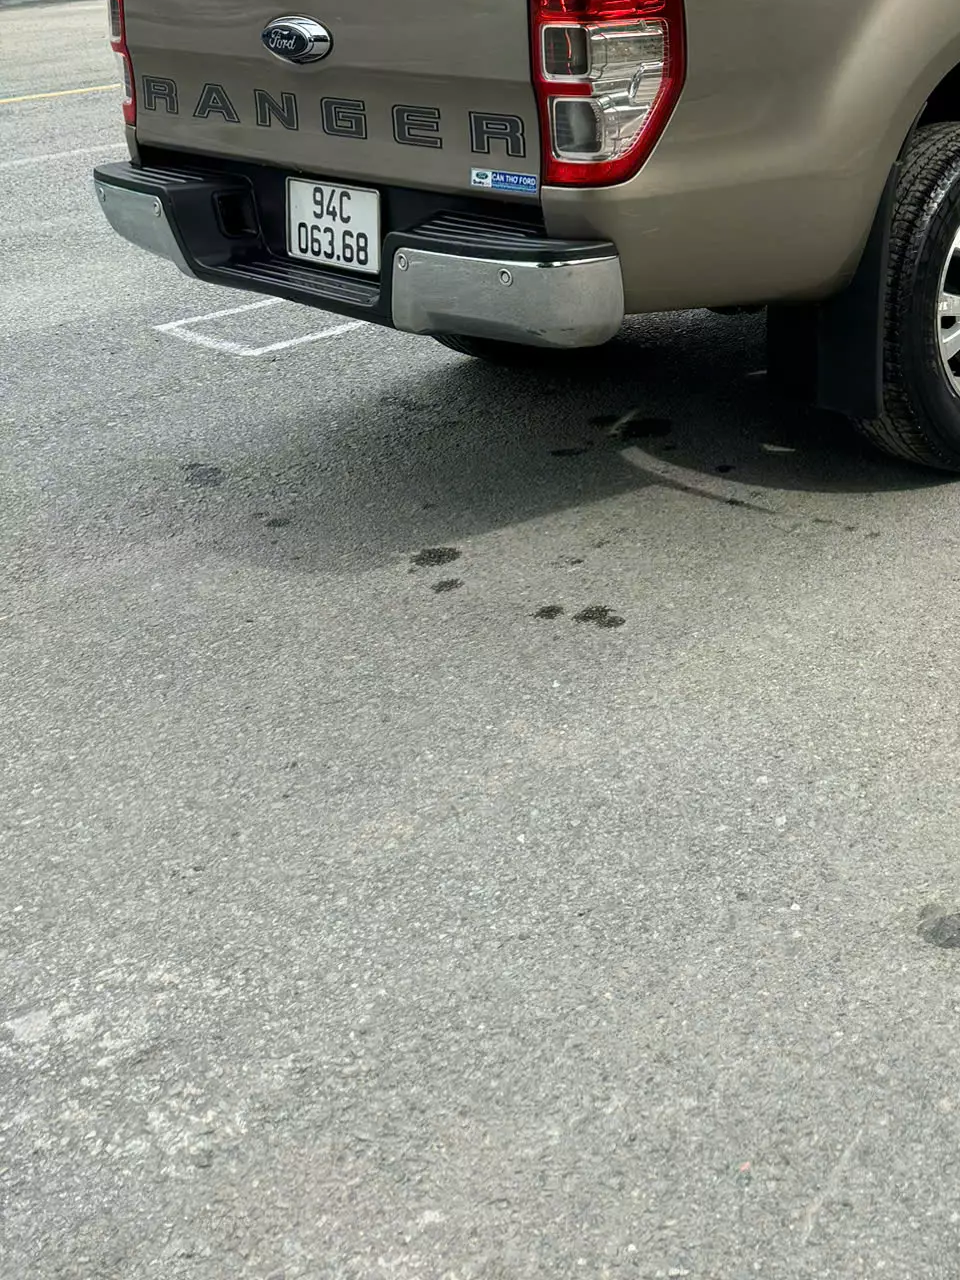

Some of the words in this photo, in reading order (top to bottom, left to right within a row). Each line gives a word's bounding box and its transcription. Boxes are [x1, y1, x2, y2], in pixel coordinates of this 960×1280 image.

[269, 28, 297, 51] Ford
[141, 75, 527, 158] RANGER
[520, 177, 536, 186] FORD
[311, 186, 351, 224] 94C
[297, 221, 369, 266] 063.68
